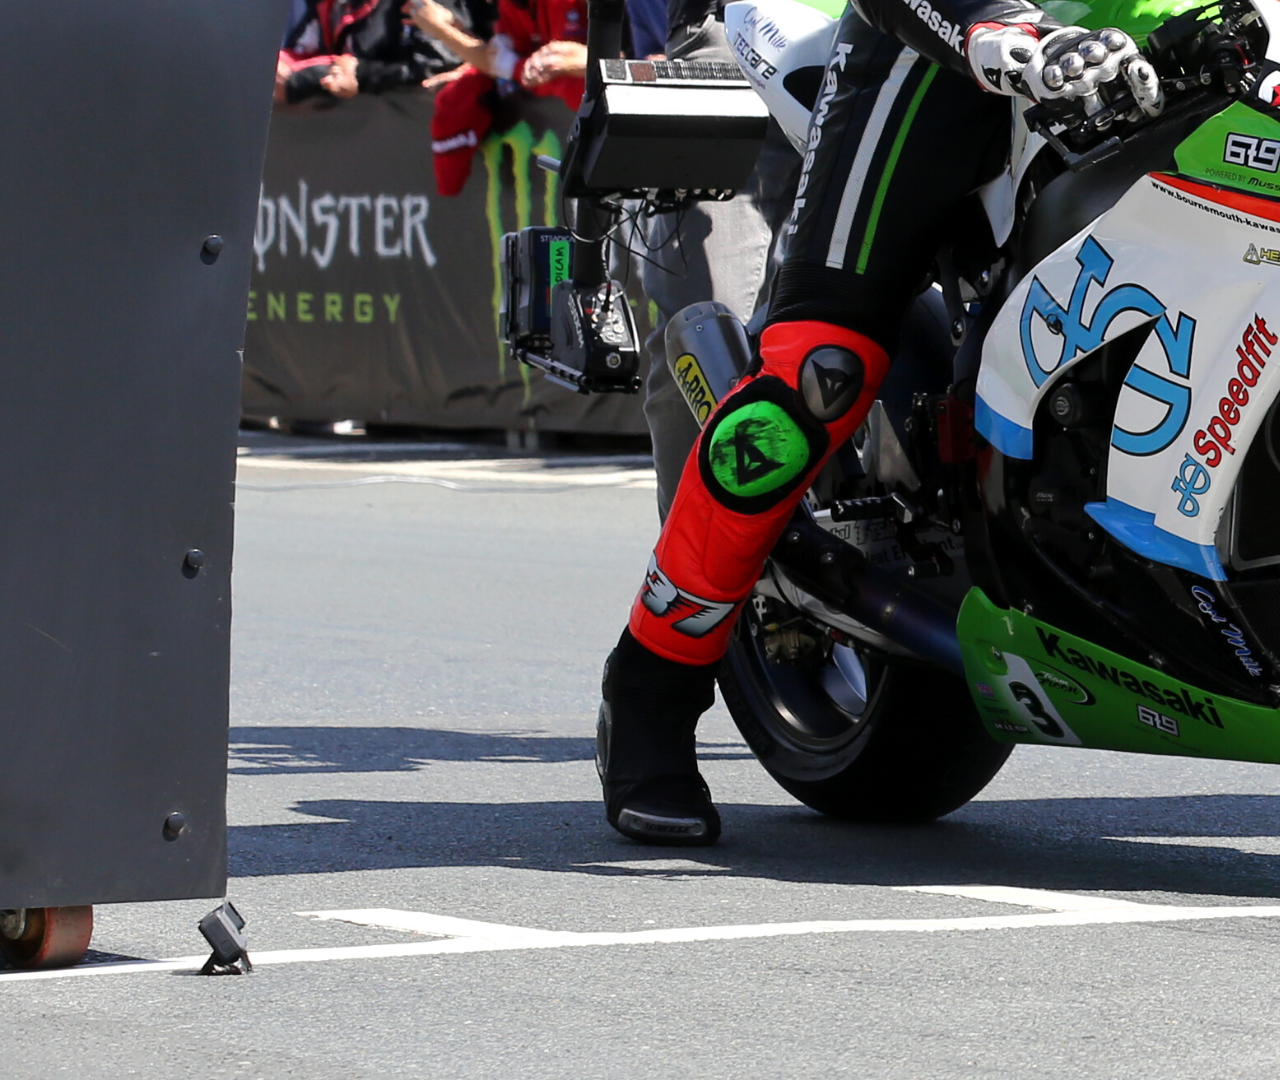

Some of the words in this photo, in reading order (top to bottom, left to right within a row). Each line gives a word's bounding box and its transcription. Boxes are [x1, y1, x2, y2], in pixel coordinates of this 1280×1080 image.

[759, 20, 788, 51] Milk
[787, 43, 854, 236] Kawasaki
[1205, 168, 1237, 182] POWERED
[1238, 173, 1247, 182] BY
[1194, 313, 1279, 468] Speedfit
[1035, 626, 1225, 730] Kawasaki
[1041, 670, 1069, 686] Team
[1220, 623, 1263, 678] Milk
[1008, 680, 1066, 739] 3
[1035, 672, 1080, 695] Green
